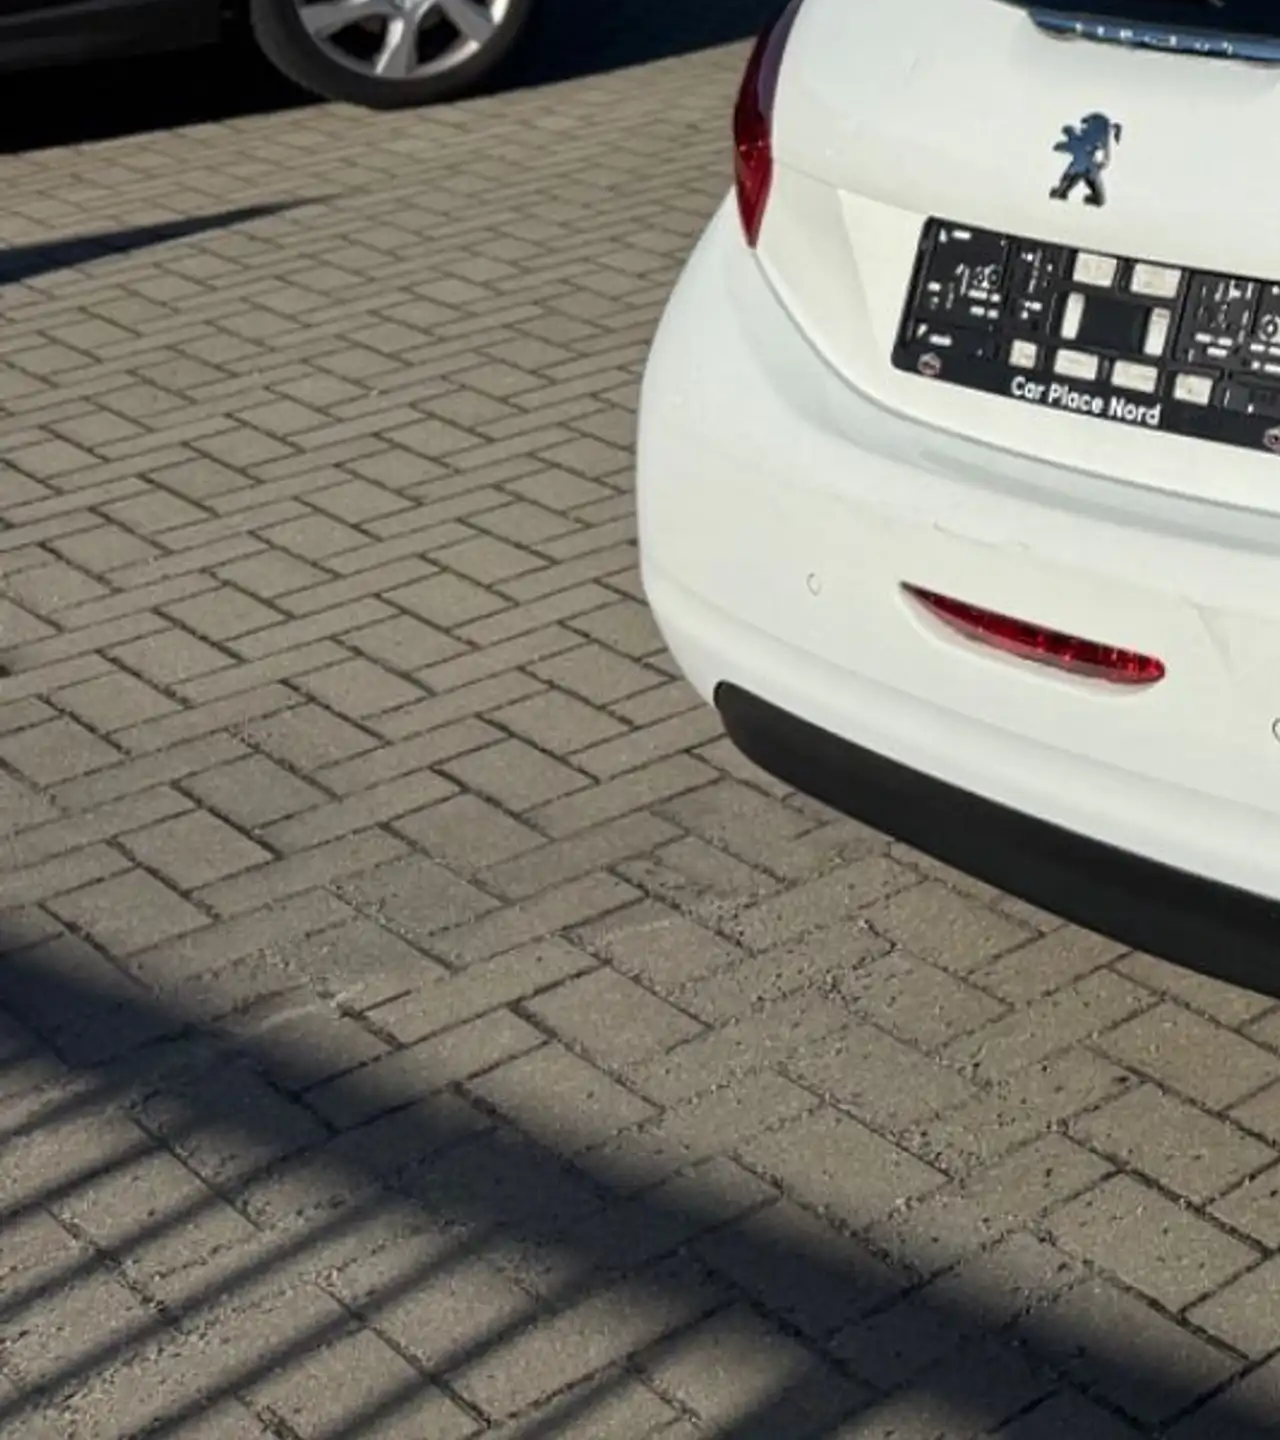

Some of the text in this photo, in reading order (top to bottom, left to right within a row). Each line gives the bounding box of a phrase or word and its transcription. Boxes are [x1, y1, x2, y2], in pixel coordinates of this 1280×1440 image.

[1010, 375, 1162, 426] Car Place Nord
